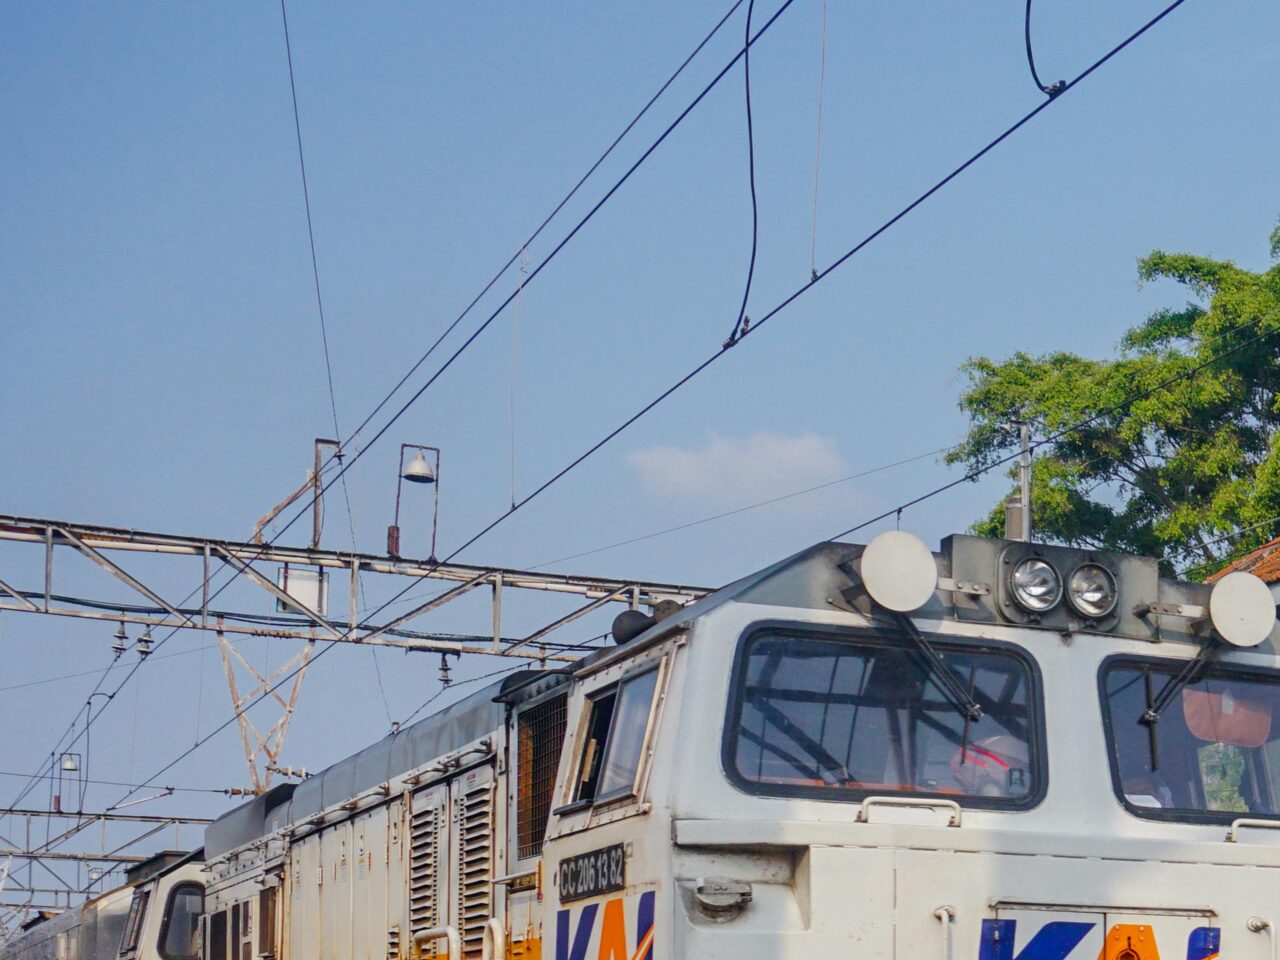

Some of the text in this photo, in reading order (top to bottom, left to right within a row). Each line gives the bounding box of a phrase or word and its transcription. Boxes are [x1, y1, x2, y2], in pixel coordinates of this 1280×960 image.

[560, 847, 623, 897] CC 206 13 82
